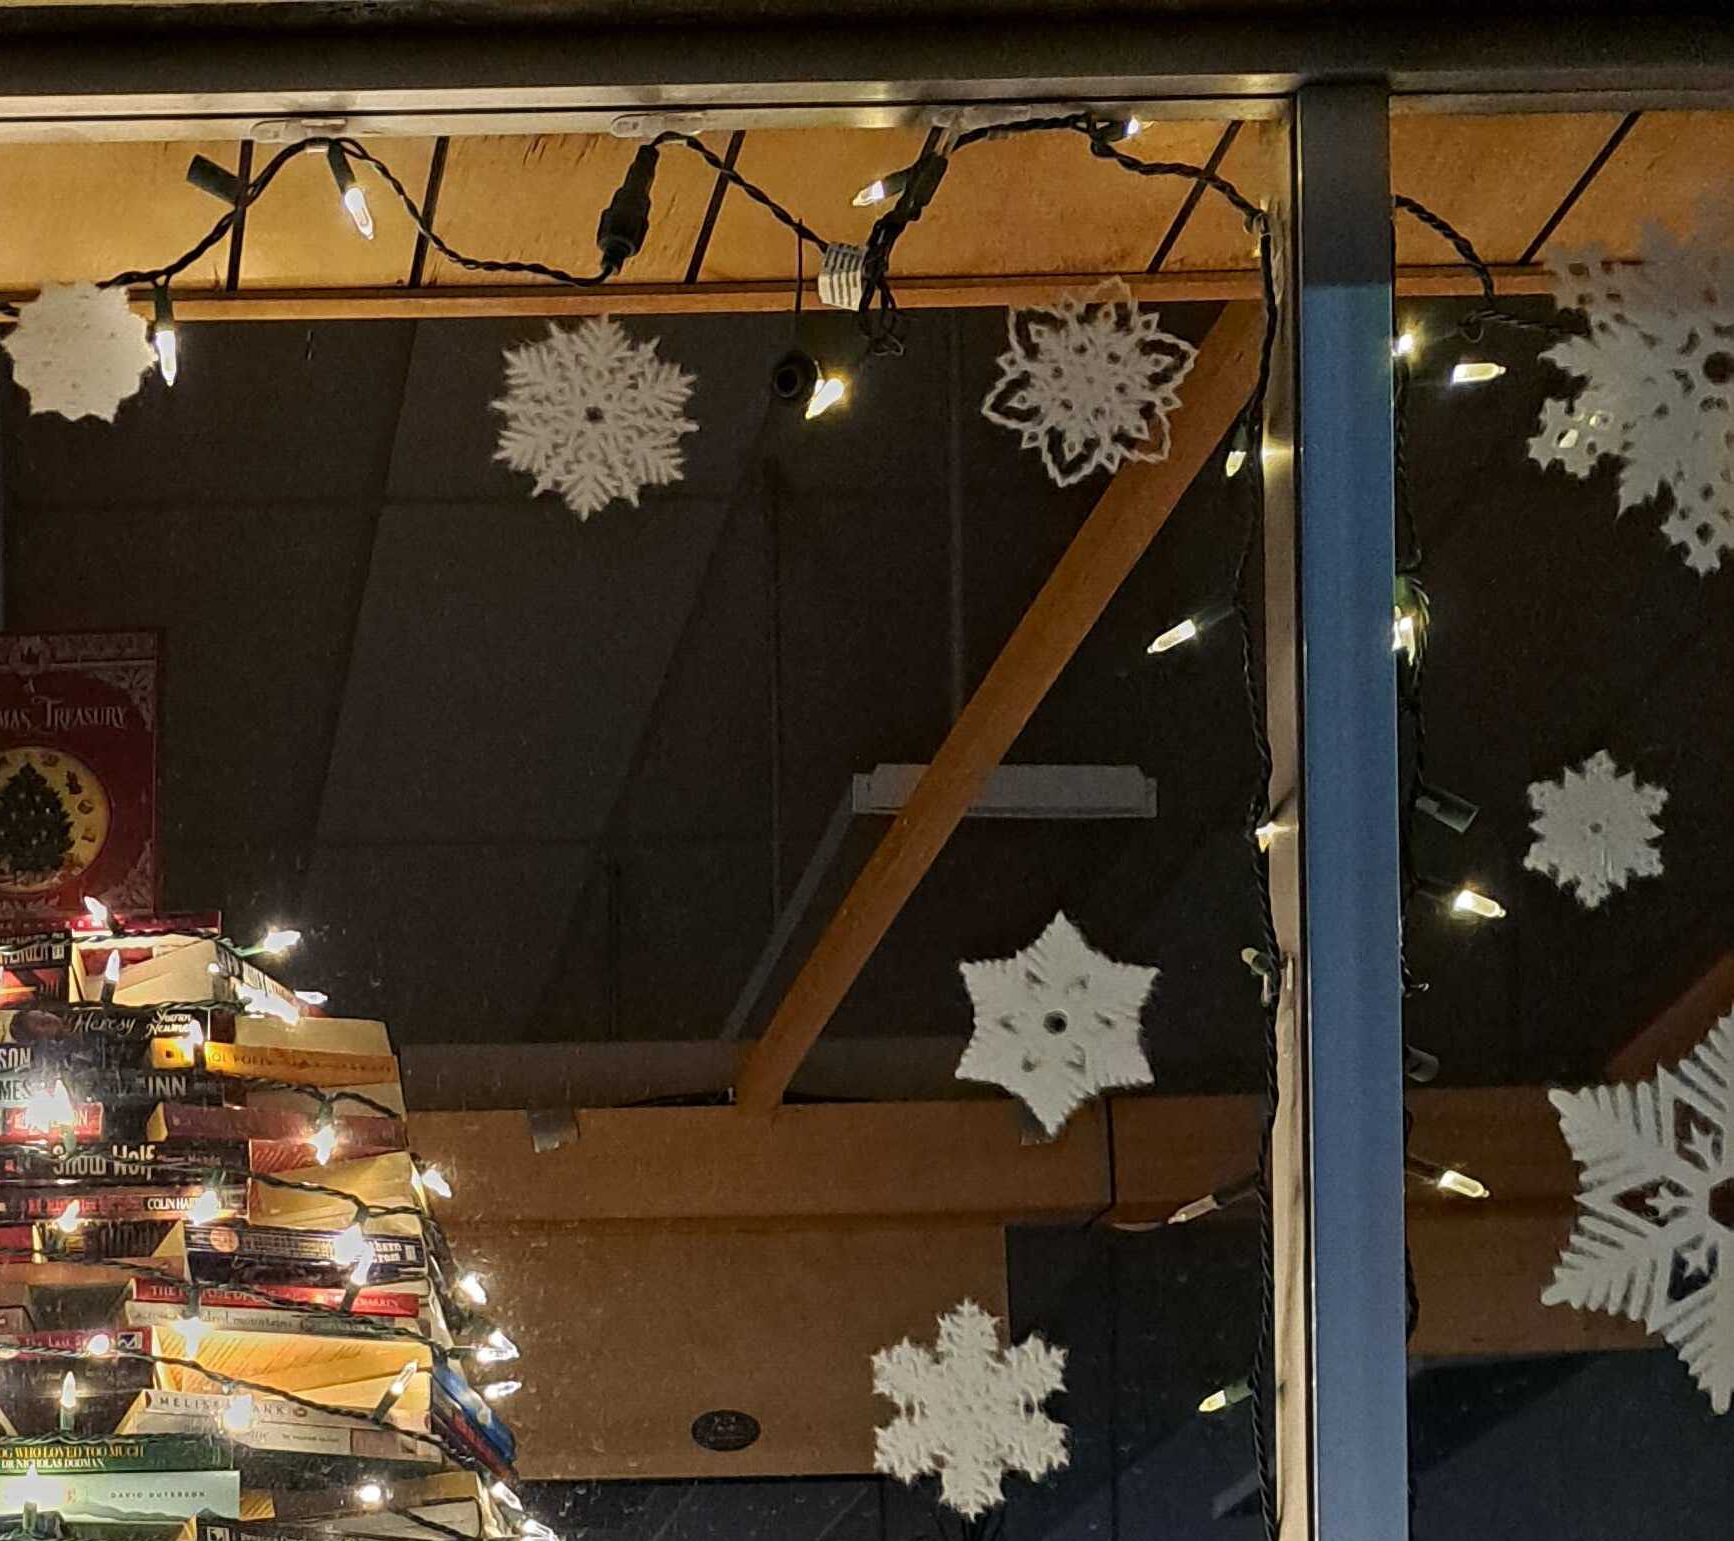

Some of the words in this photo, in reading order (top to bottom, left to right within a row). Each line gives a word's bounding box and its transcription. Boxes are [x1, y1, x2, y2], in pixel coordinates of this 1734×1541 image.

[34, 695, 125, 732] TREASURY
[73, 1012, 136, 1034] Heresy
[147, 1075, 187, 1097] INN
[110, 1490, 144, 1500] DAVID
[149, 1490, 207, 1501] GUTERSON
